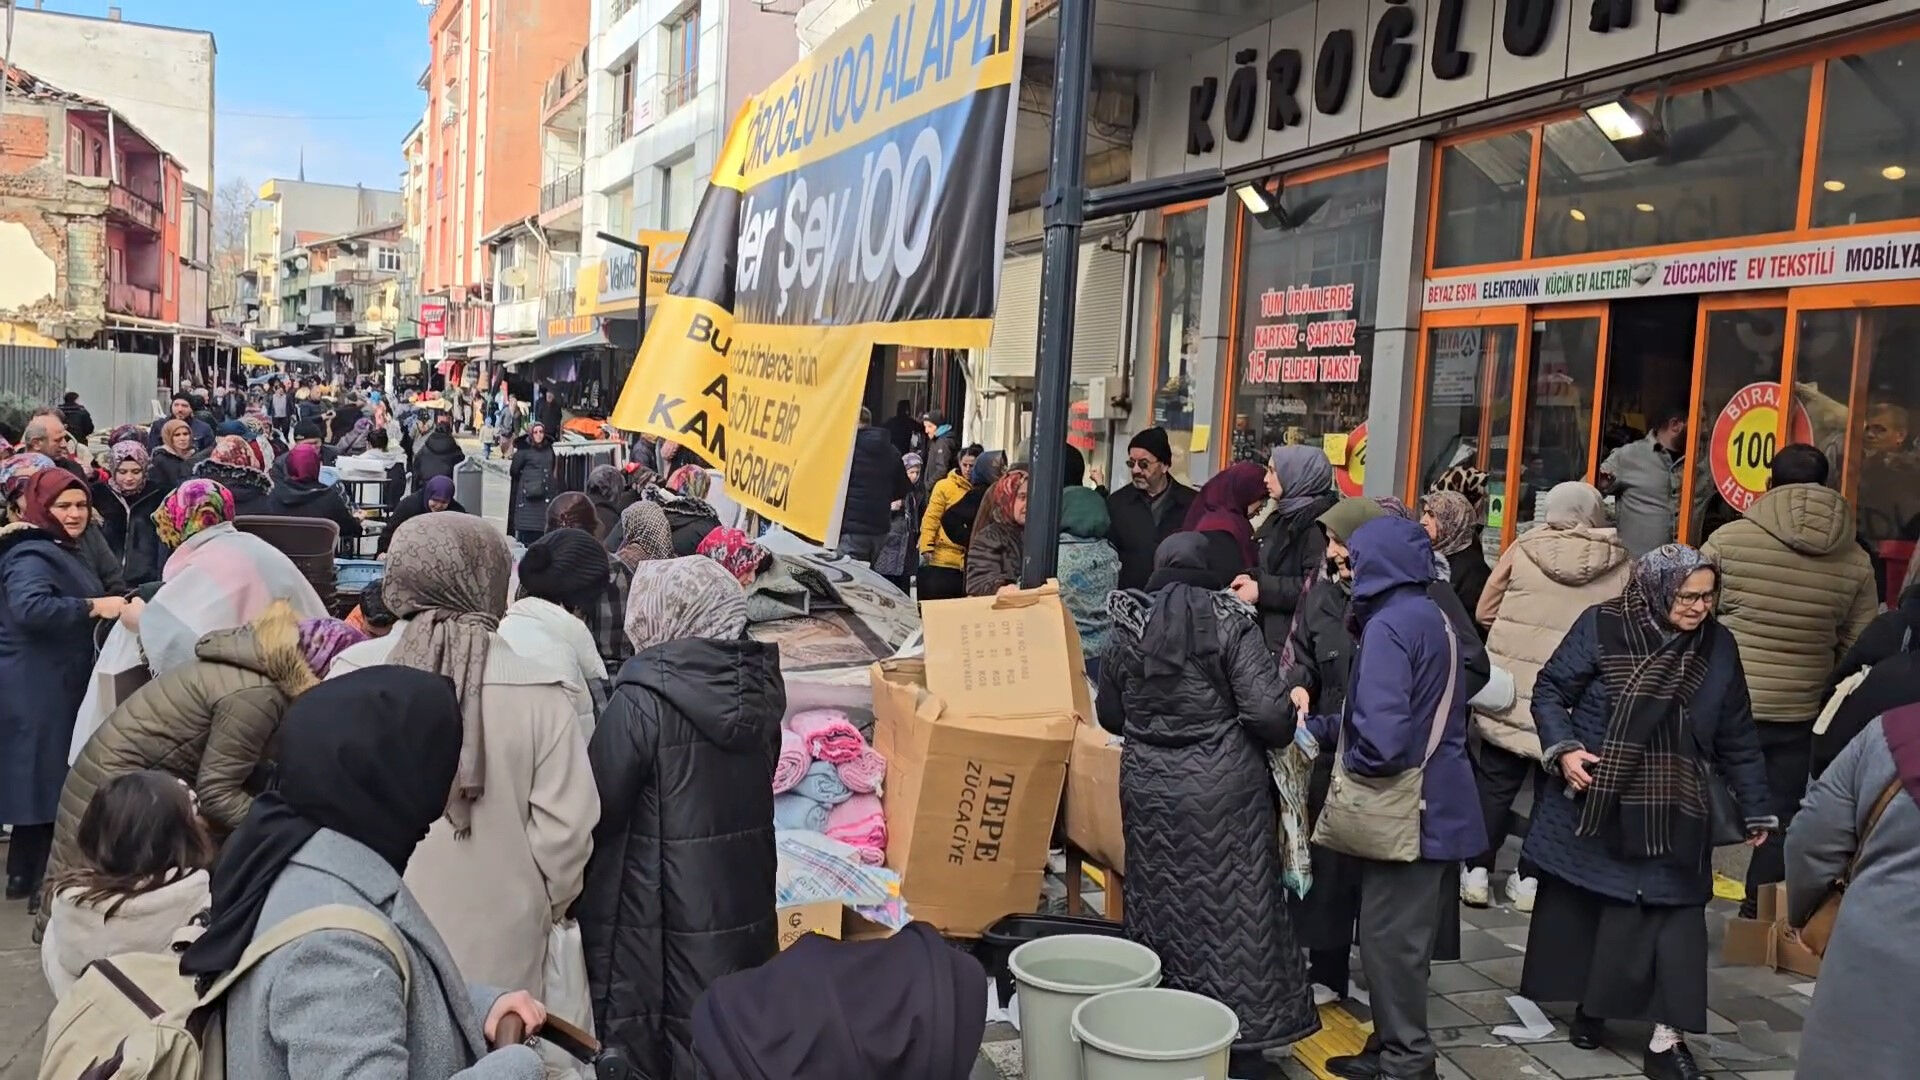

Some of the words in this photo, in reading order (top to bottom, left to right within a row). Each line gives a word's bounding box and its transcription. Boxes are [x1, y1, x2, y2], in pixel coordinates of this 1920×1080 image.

[740, 64, 828, 174] ÖROĞLU
[824, 33, 875, 138] 100
[777, 177, 851, 320] Şey
[848, 126, 942, 284] 100
[1261, 288, 1285, 317] TÜM
[1286, 284, 1354, 315] ÜRÜNLERDE
[1428, 286, 1454, 303] BEYAZ
[1483, 274, 1540, 299] ELEKTRONİK
[1545, 275, 1575, 297] KÜÇÜK
[1576, 272, 1588, 292] EV
[1589, 266, 1632, 291] ALETLERİ
[1663, 256, 1738, 286] ZÜCCACİYE
[1747, 257, 1766, 280] EV
[1770, 246, 1836, 279] TEKSTİLİ
[1845, 240, 1920, 273] MOBİLYA
[746, 342, 793, 383] binlerce
[1255, 323, 1298, 350] KARTSIZ
[1306, 320, 1357, 351] ŞARTSIZ
[1249, 351, 1266, 384] 15
[1266, 358, 1281, 382] AY
[1282, 356, 1318, 382] ELDEN
[1320, 351, 1361, 382] TAKSİT
[728, 385, 775, 442] BÖYLE
[772, 394, 800, 446] BİR
[1726, 387, 1781, 420] BURA
[730, 447, 798, 511] GÖRMEDİ
[1733, 431, 1776, 469] 100
[948, 761, 982, 866] ZÜCCACİYE
[973, 773, 1015, 862] TEPE
